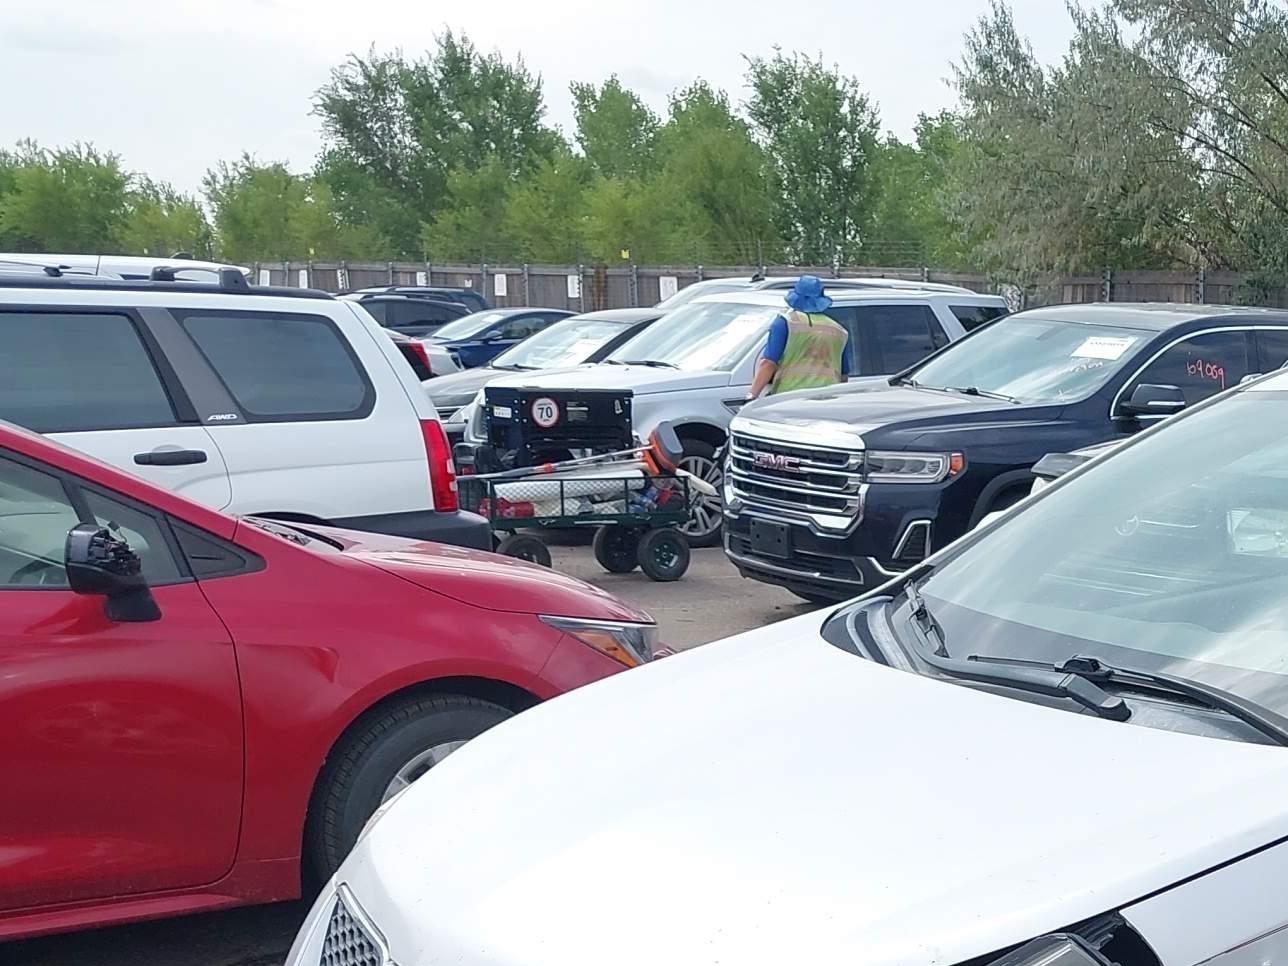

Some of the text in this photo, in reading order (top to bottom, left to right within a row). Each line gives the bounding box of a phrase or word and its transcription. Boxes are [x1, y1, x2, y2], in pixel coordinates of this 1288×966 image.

[207, 413, 238, 421] AWD
[538, 406, 553, 419] 70
[752, 452, 800, 473] GMC
